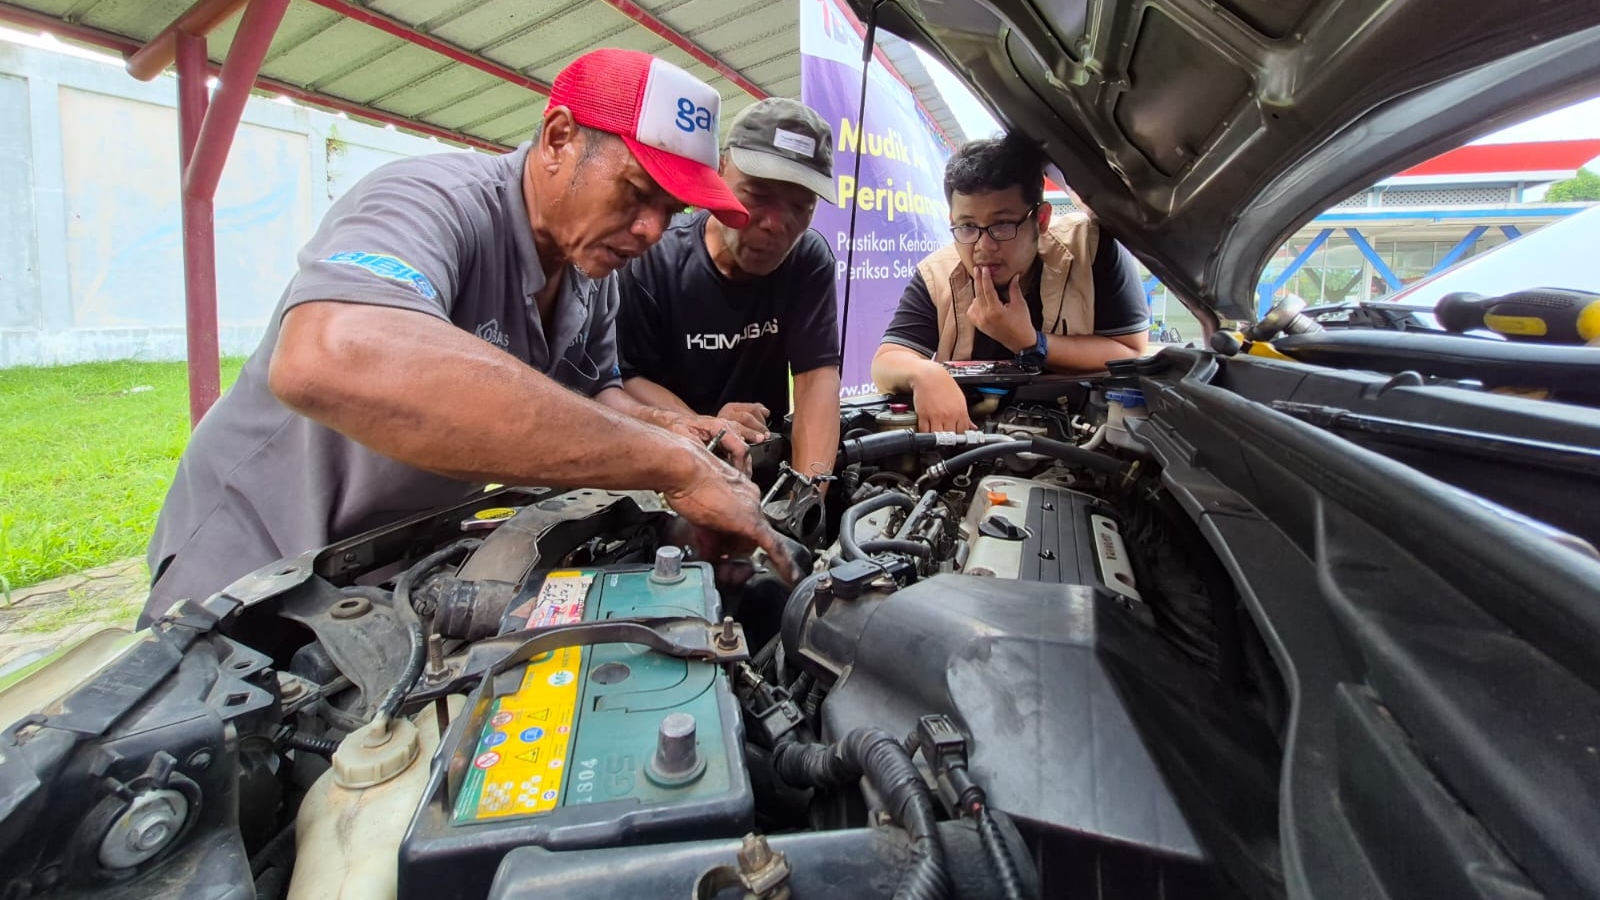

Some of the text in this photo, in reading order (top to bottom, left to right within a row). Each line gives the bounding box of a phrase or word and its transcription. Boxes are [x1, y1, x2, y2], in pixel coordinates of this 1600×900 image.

[675, 97, 714, 133] ga
[838, 117, 911, 166] Mudik
[837, 230, 896, 252] Pastikan
[837, 258, 916, 280] Periksa Sek
